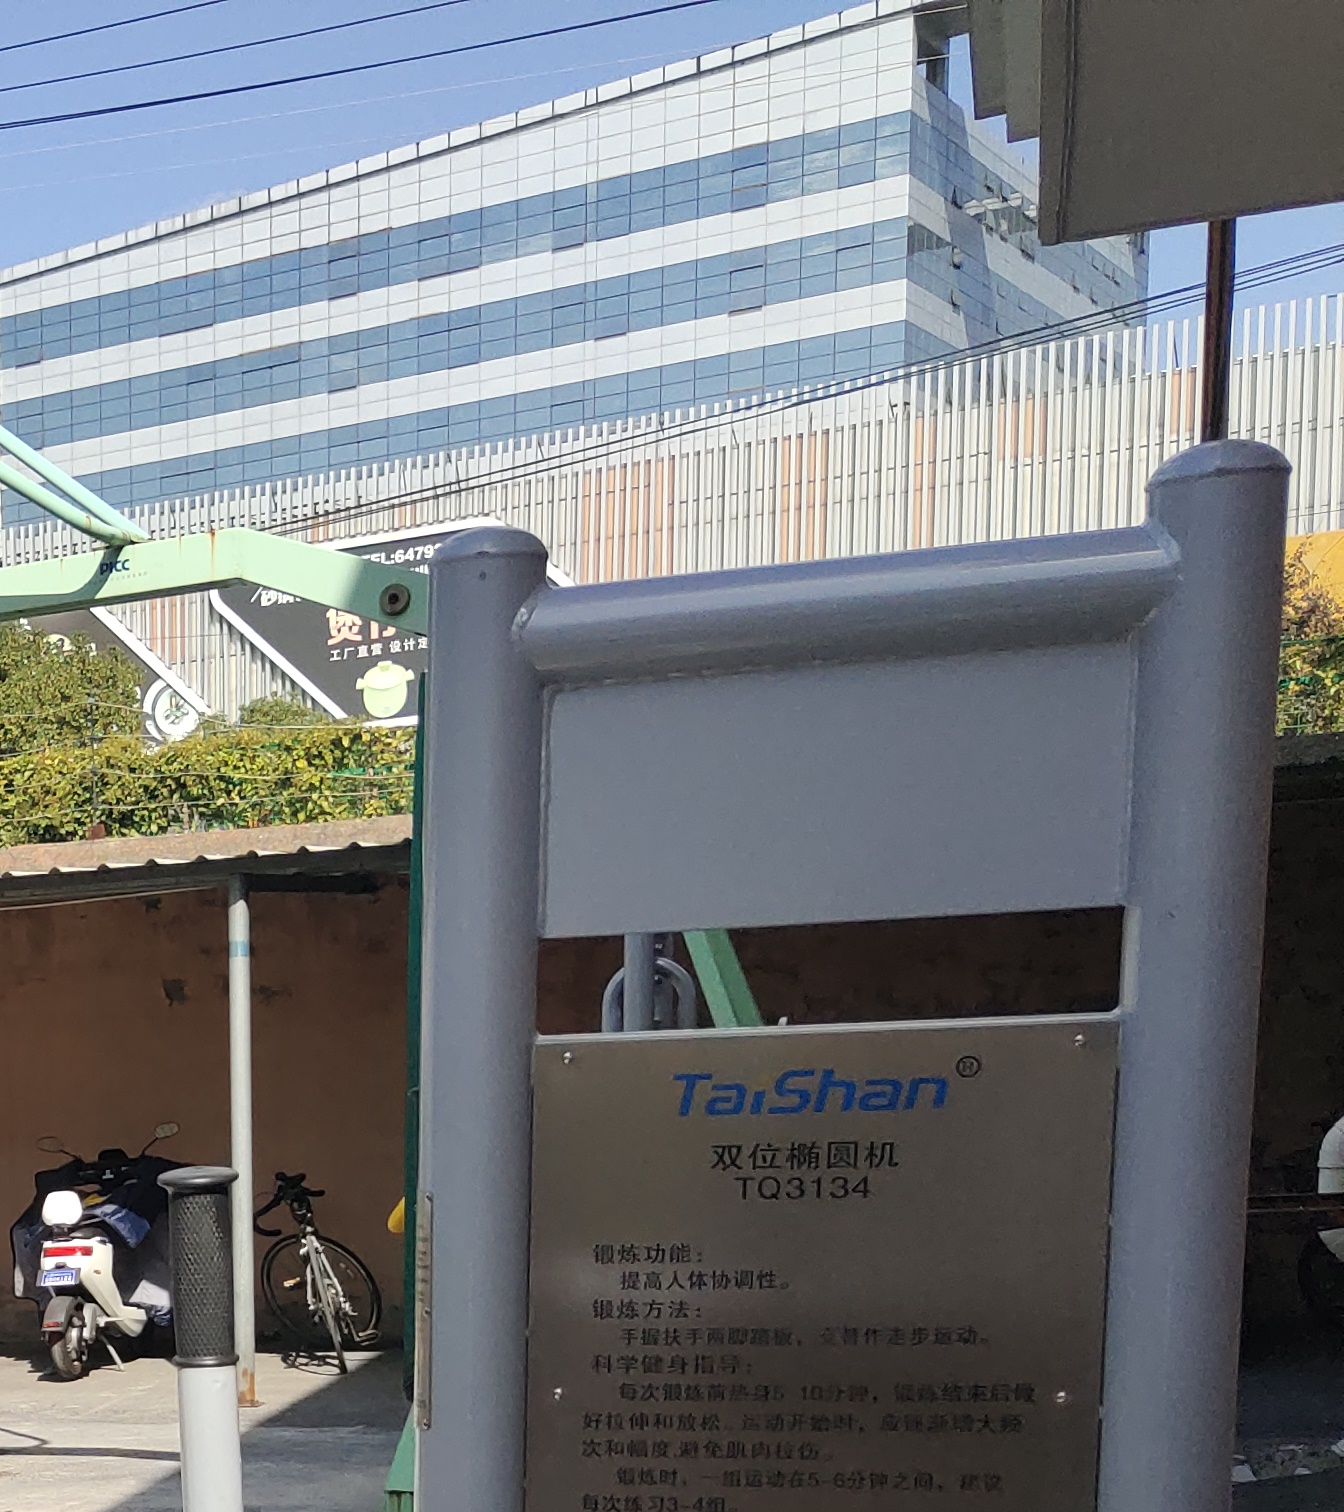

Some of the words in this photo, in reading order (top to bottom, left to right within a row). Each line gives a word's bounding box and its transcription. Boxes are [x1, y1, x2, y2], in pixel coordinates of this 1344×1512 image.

[329, 643, 383, 662] 工厂直营
[673, 1068, 949, 1117] TaiShan
[711, 1142, 899, 1171] 双位椭圆机
[734, 1175, 873, 1201] TQ3134
[620, 1270, 790, 1291] 提高人体协调性。
